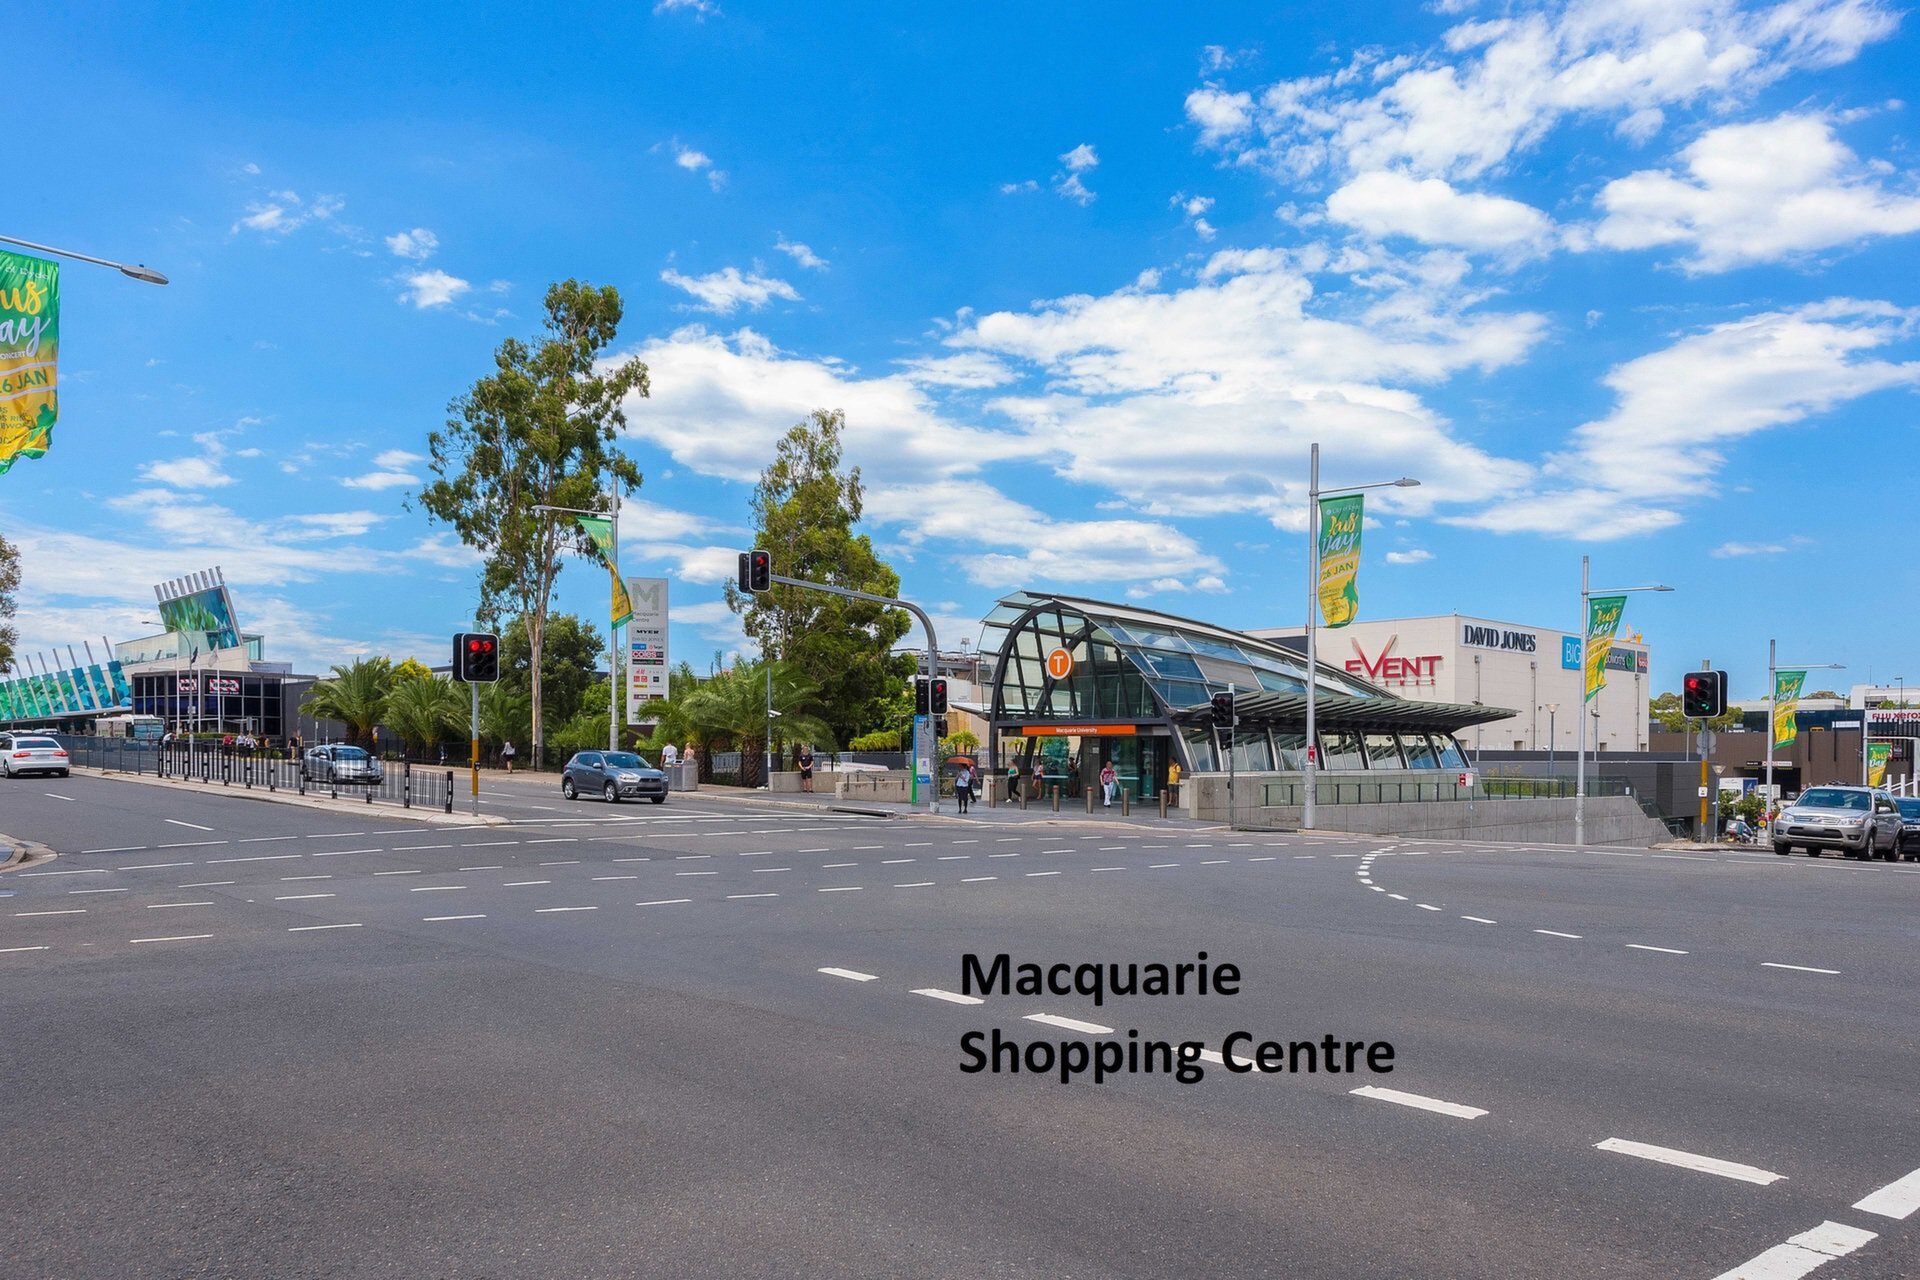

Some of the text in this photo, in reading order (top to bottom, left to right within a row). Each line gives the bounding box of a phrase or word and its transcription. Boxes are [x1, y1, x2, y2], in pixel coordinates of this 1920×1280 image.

[0, 370, 47, 393] 6 JAN
[1333, 562, 1354, 577] JAN
[1464, 624, 1536, 653] DAVID JONES
[1345, 633, 1444, 679] EVENT
[1566, 642, 1581, 663] BIG
[1053, 655, 1064, 673] T
